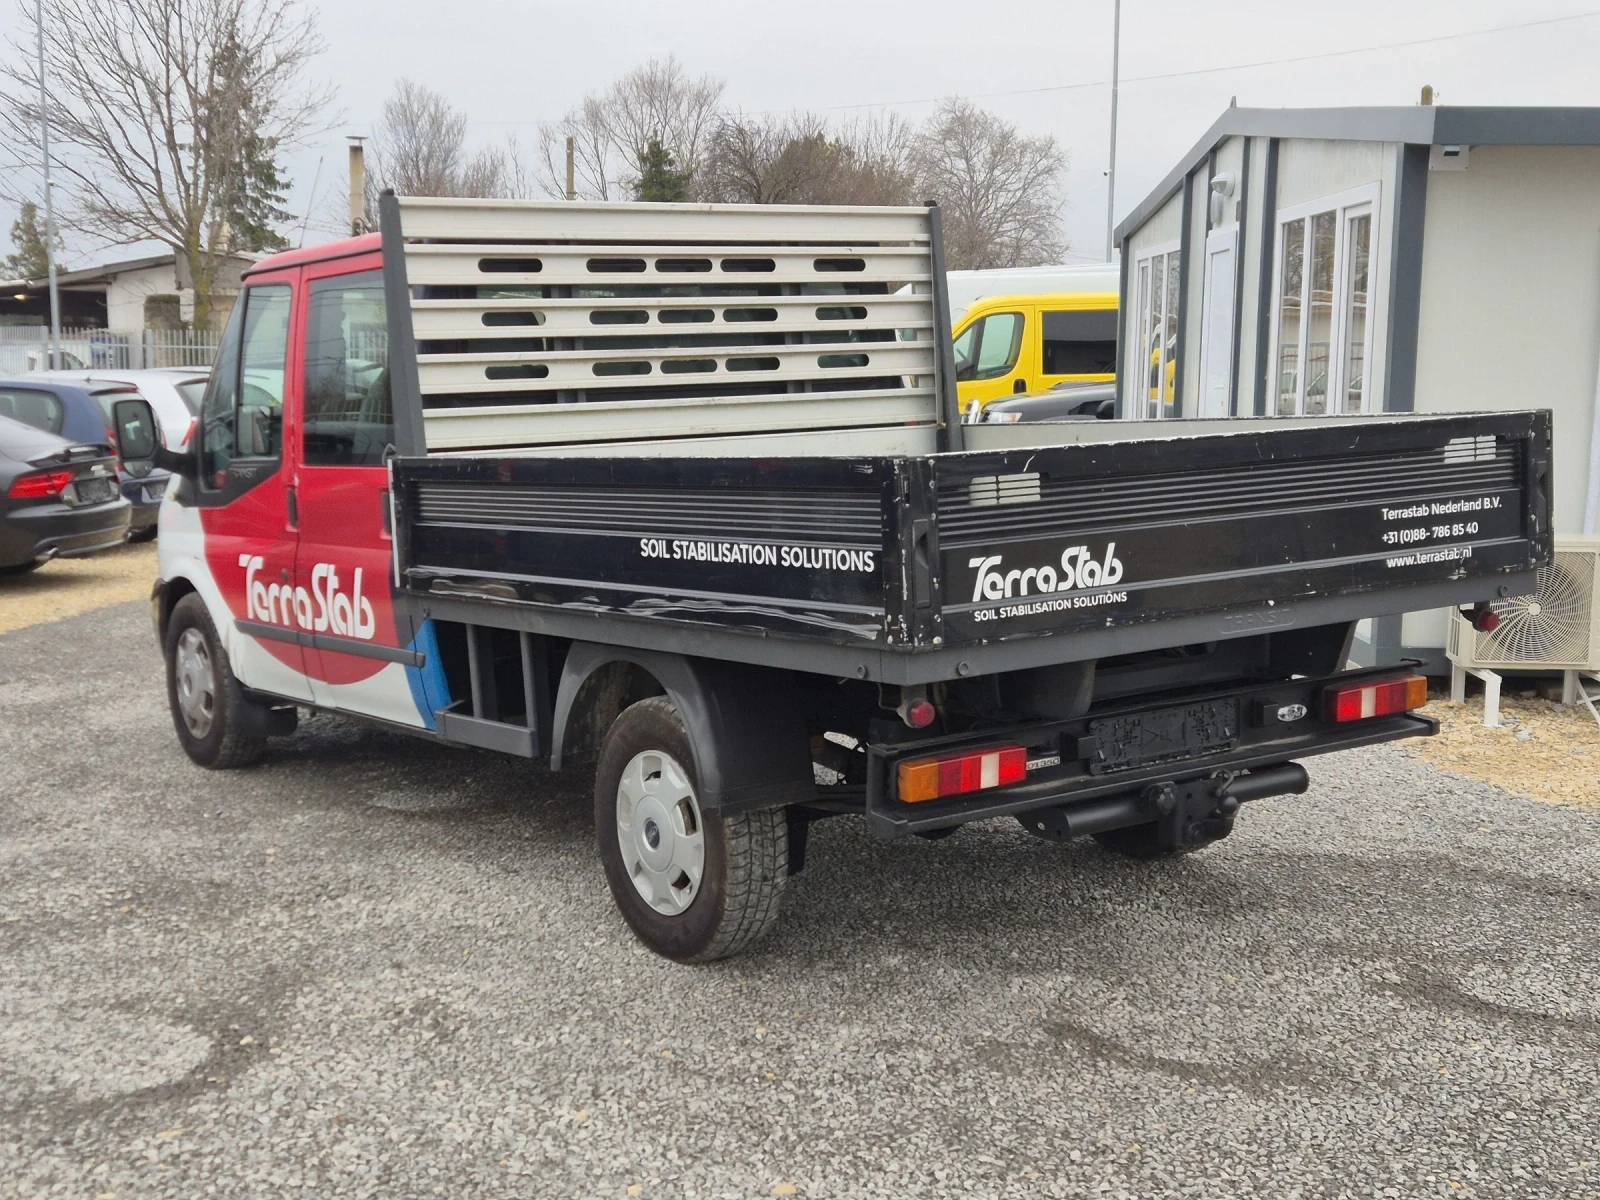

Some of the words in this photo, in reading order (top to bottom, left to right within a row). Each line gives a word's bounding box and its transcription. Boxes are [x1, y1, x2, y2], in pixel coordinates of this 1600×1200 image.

[1381, 504, 1429, 521] Terrastab
[1431, 498, 1482, 516] Nederland
[1483, 496, 1502, 509] B.V.
[1382, 531, 1398, 544] +31
[1400, 528, 1430, 544] (0)88-
[1432, 526, 1451, 539] 786
[1452, 524, 1464, 536] 85
[1466, 522, 1479, 534] 40
[640, 538, 671, 559] SOIL
[672, 540, 777, 566] STABILISATION
[780, 546, 875, 573] SOLUTIONS
[1386, 546, 1472, 568] www.terrastab.nl
[968, 542, 1124, 602] TerraStab
[238, 553, 375, 640] TerraStab
[974, 609, 998, 622] SOIL
[999, 599, 1072, 619] STABILISATION
[1073, 591, 1128, 609] SOLUTIONS
